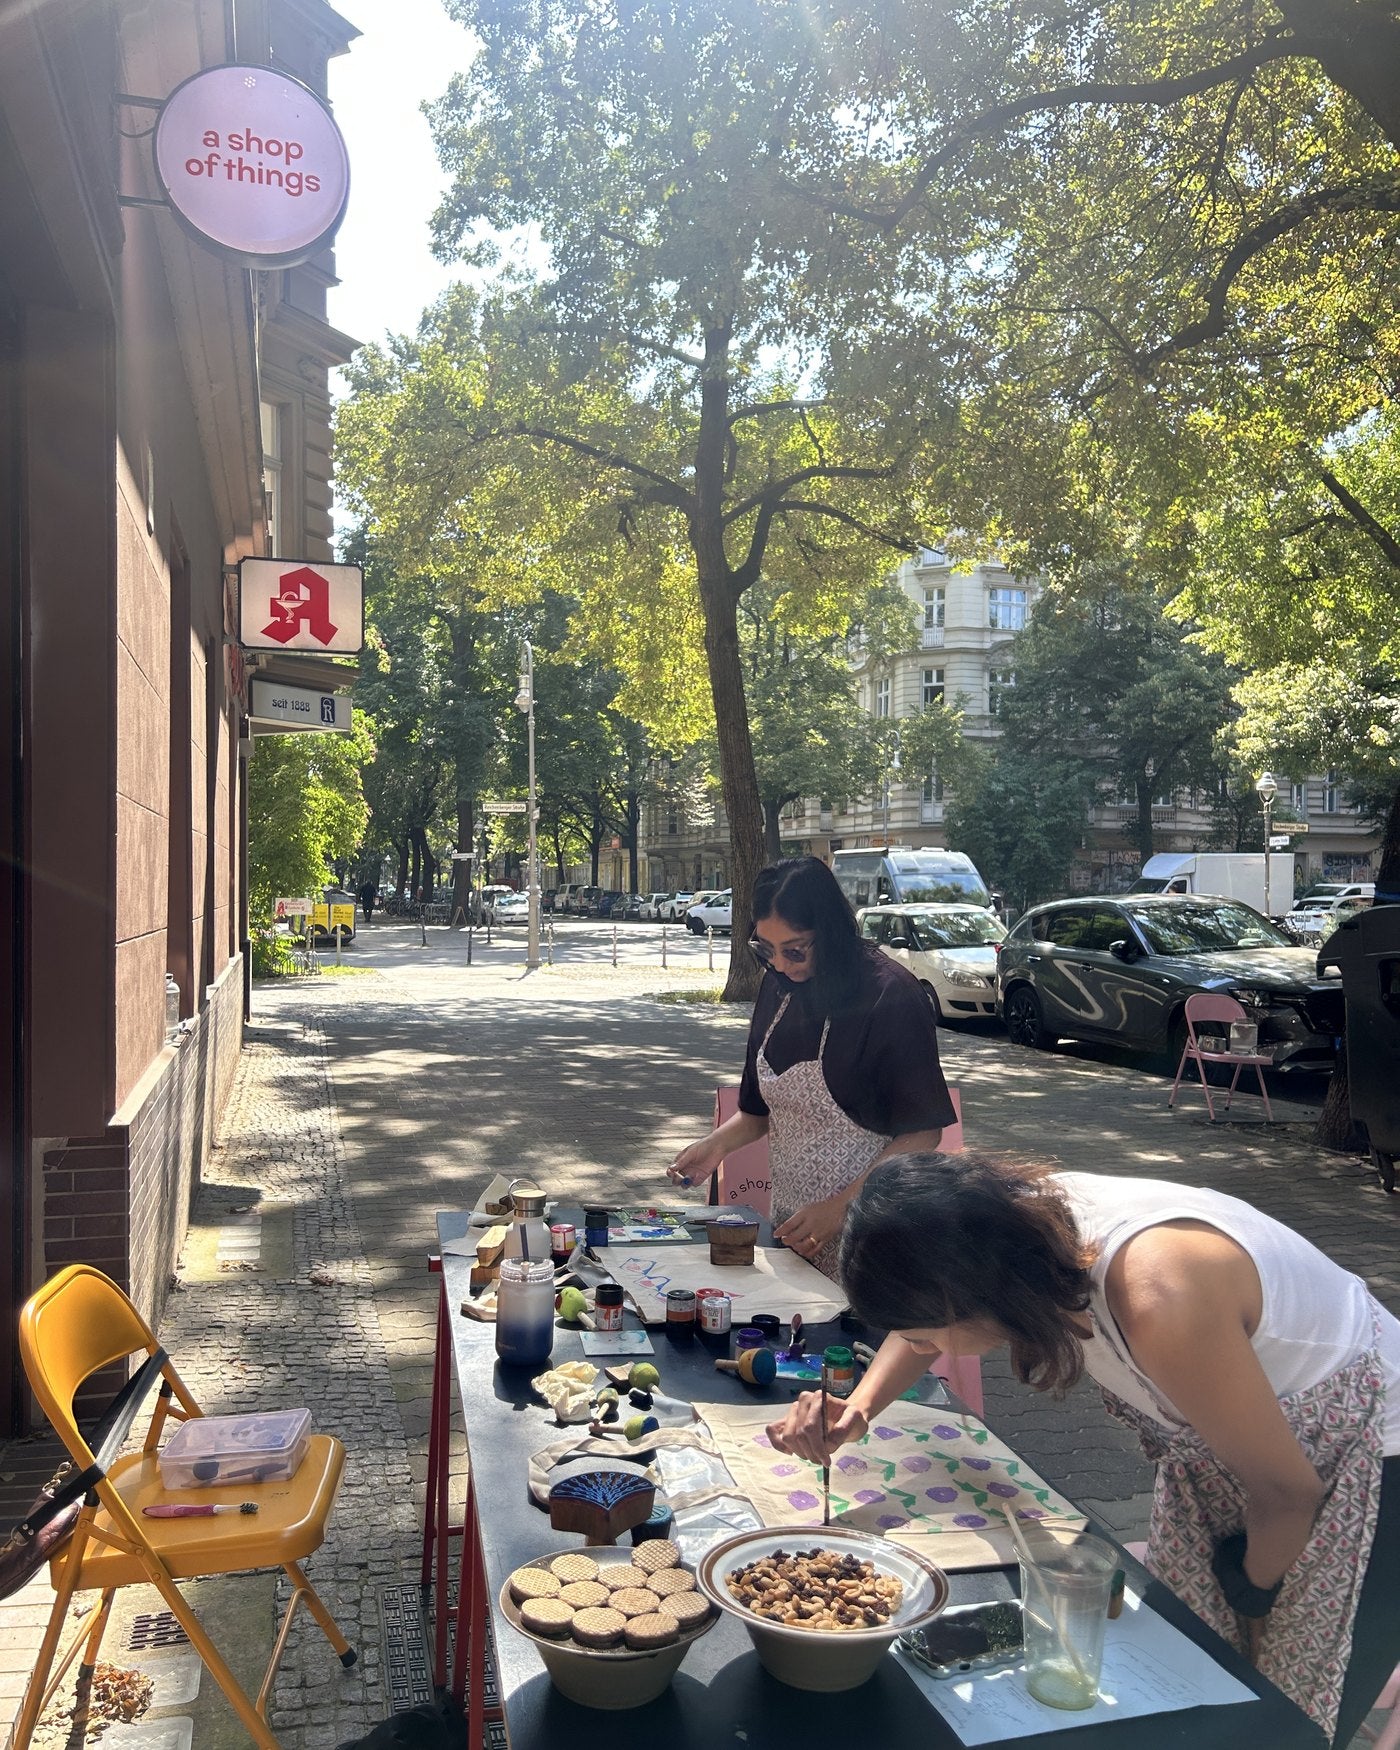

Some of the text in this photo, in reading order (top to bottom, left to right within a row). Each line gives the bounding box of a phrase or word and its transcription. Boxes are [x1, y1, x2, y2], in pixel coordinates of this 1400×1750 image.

[202, 127, 304, 165] a shop
[185, 152, 321, 197] of things
[272, 697, 311, 712] seit 1888
[729, 1178, 773, 1200] a shop
